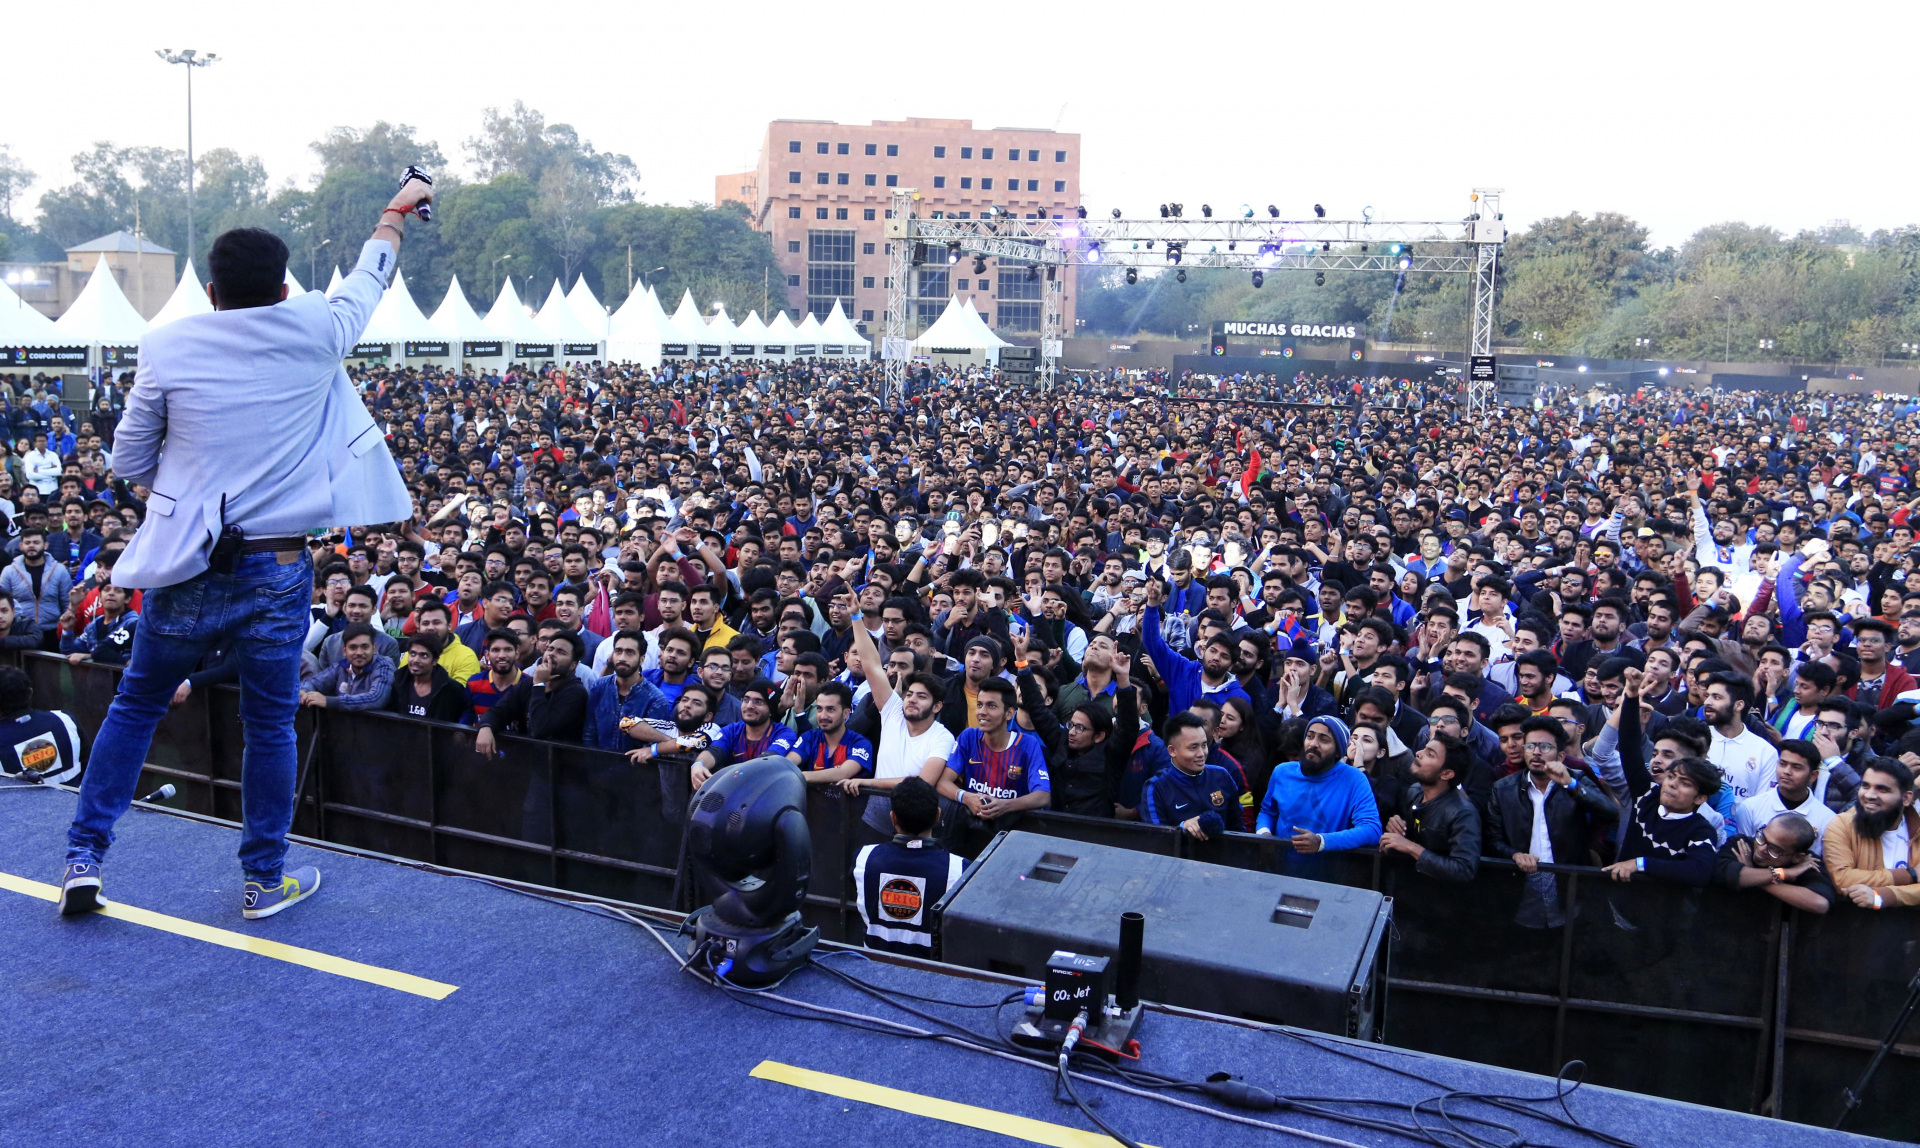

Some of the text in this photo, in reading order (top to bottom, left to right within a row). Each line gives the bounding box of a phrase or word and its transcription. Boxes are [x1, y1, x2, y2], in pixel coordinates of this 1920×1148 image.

[1224, 322, 1356, 338] MUCHAS GRACIAS
[25, 747, 54, 765] TRIG
[852, 747, 869, 760] beko
[968, 777, 1018, 799] Rakuten
[884, 892, 918, 907] TRIG
[1073, 985, 1091, 999] Jet
